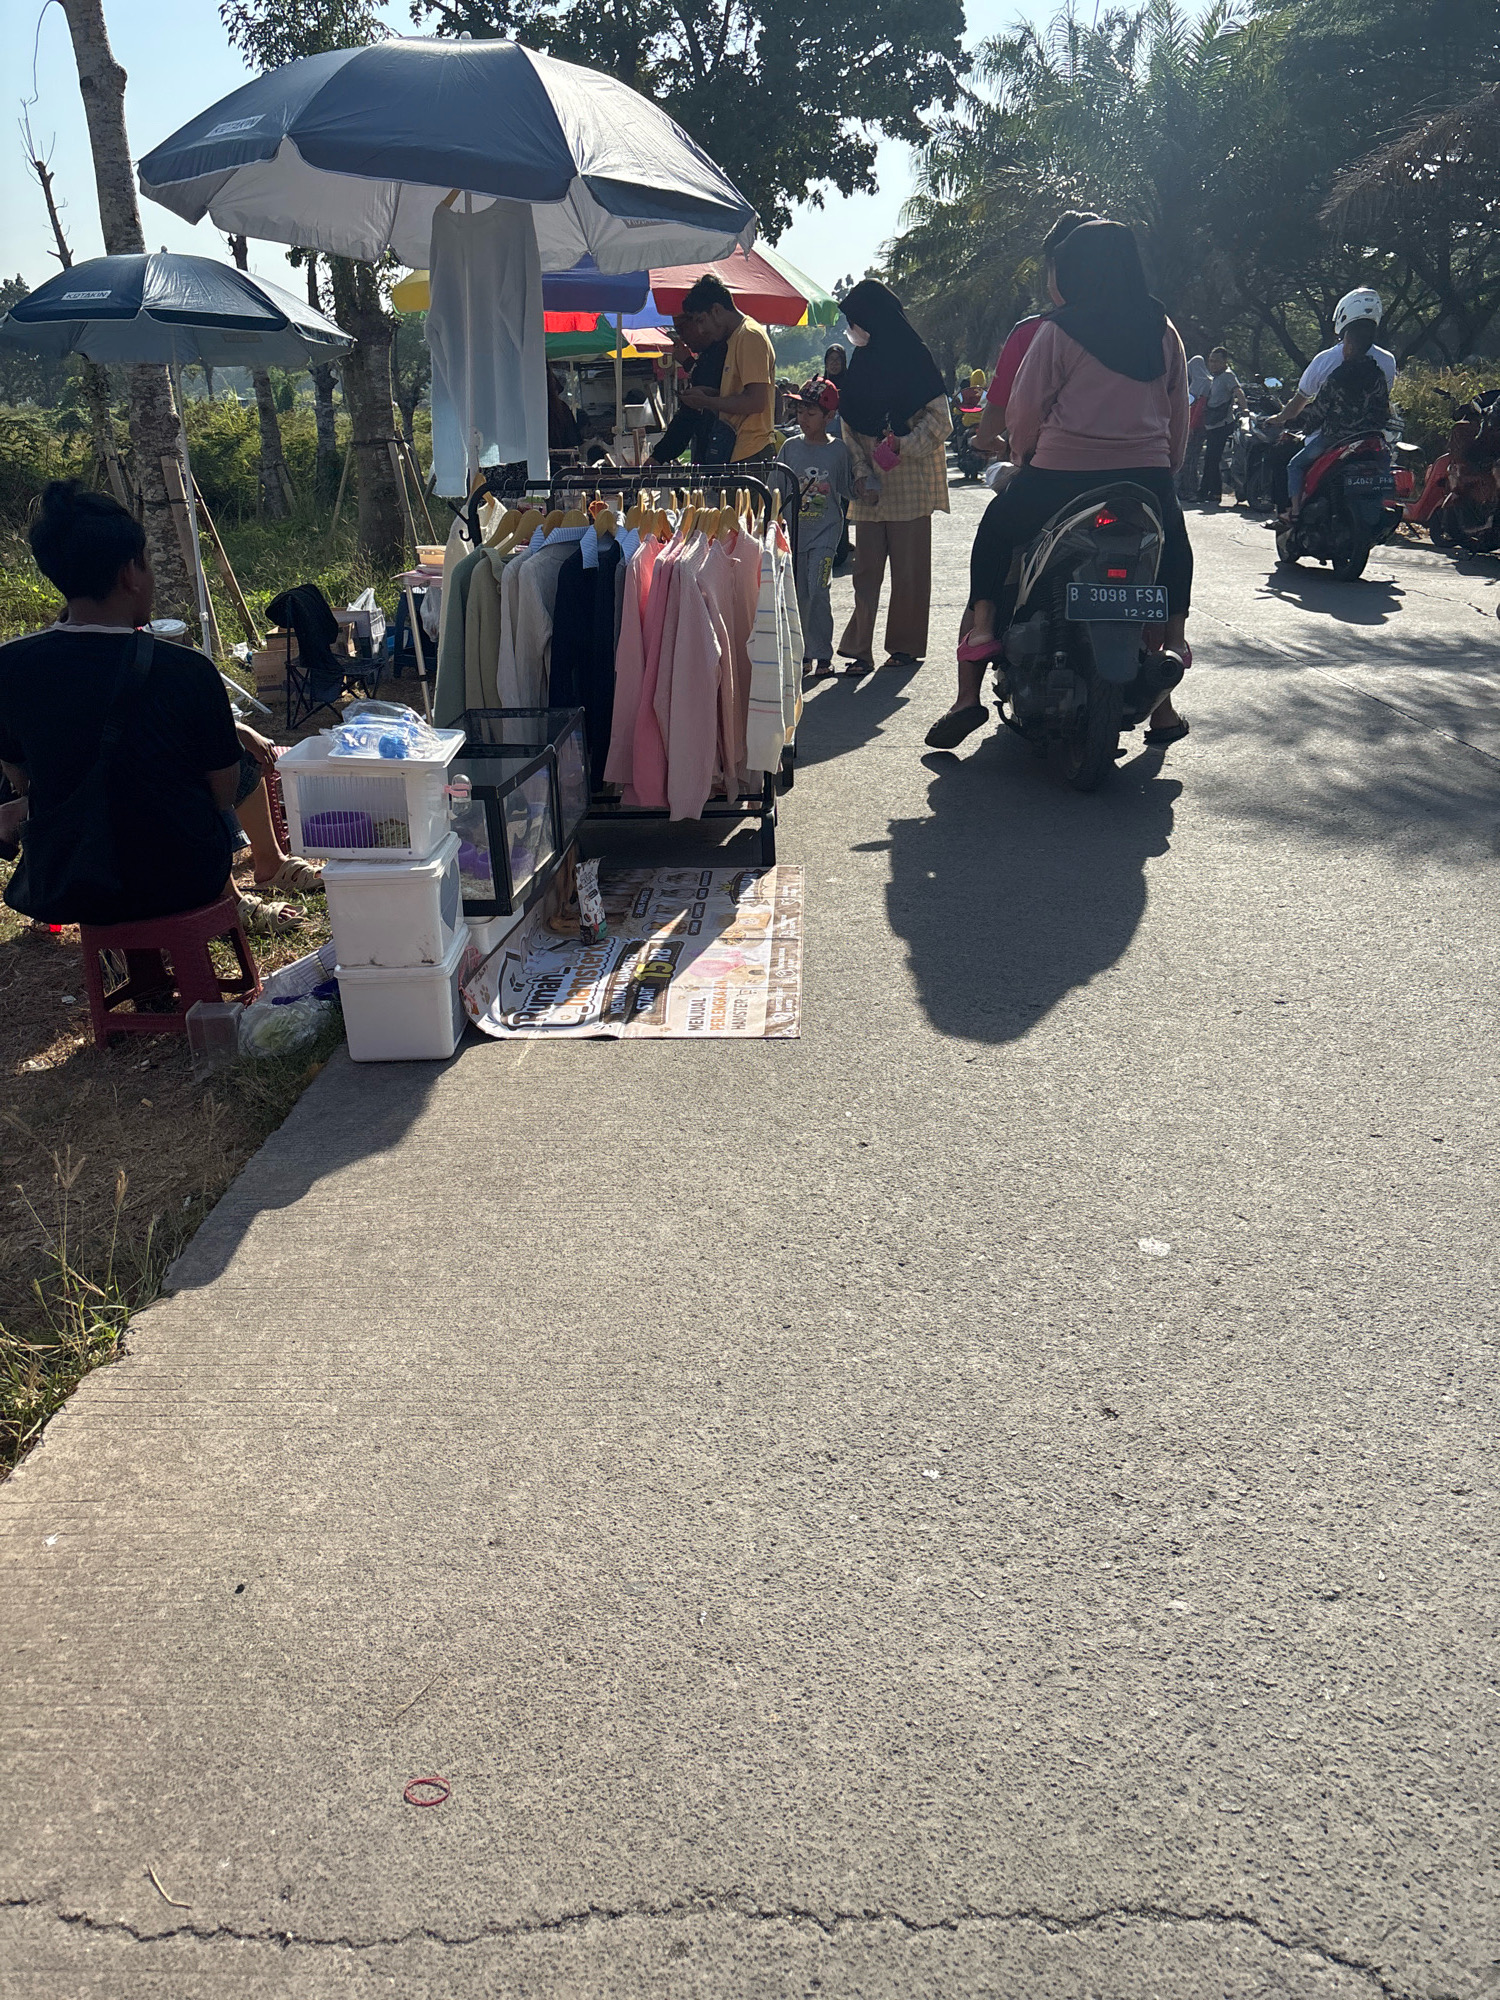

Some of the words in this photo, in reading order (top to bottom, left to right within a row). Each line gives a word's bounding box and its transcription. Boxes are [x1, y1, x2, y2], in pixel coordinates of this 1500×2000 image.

[1070, 587, 1079, 601] B
[1090, 588, 1127, 602] 3098
[1135, 589, 1164, 604] FSA
[616, 953, 639, 982] HAMSTER
[648, 948, 672, 962] RB
[634, 962, 674, 981] 15
[610, 982, 629, 1014] MENJUAL
[636, 987, 656, 1011] START
[688, 998, 707, 1031] MENJUAL
[731, 998, 749, 1030] HAMSTER
